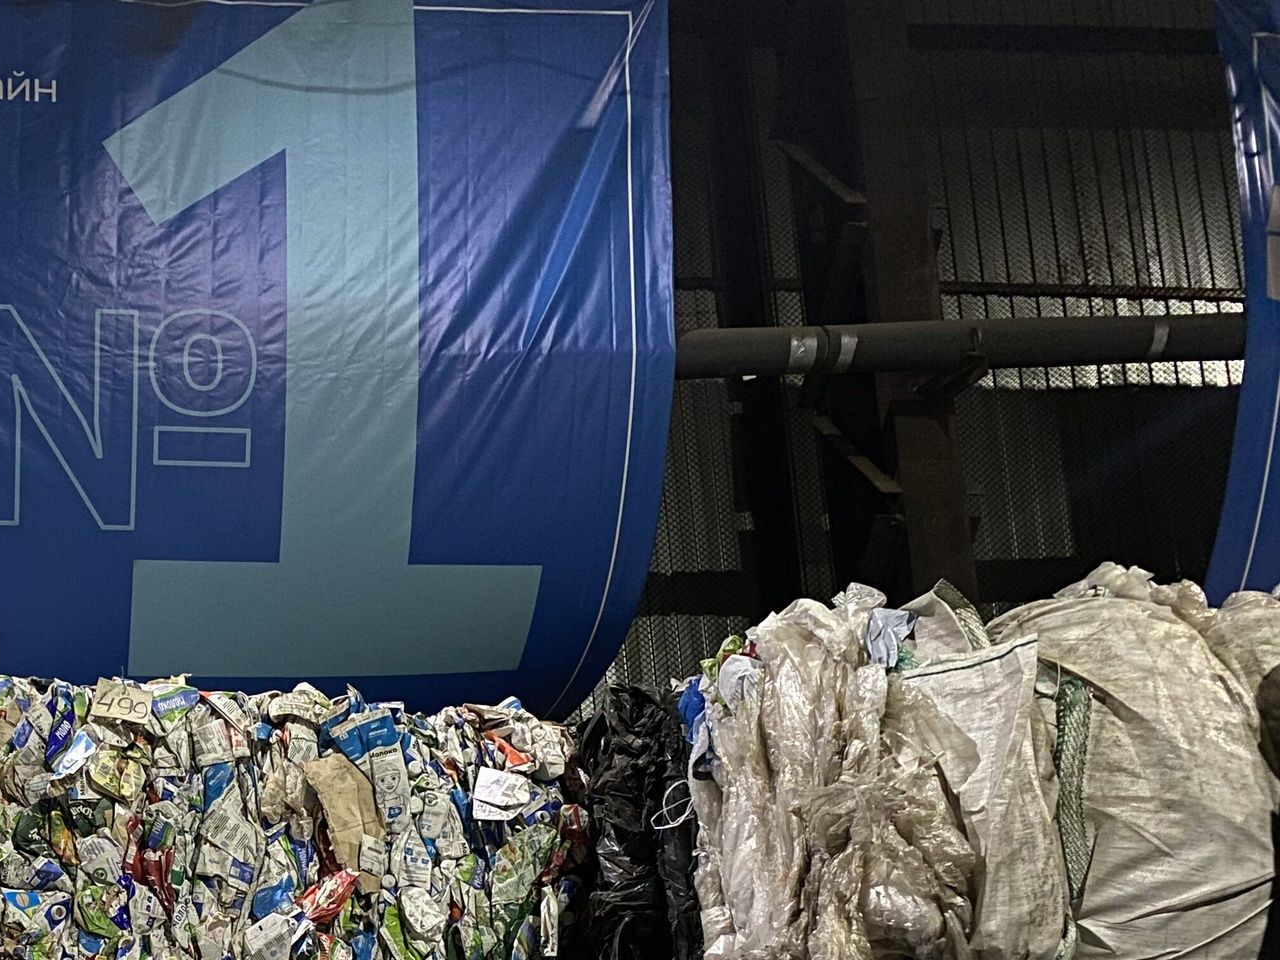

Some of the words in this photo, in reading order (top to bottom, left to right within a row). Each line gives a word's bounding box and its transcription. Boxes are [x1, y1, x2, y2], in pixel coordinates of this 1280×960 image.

[102, 0, 543, 677] 1
[96, 697, 148, 720] 499
[156, 696, 185, 712] МОЛОКО
